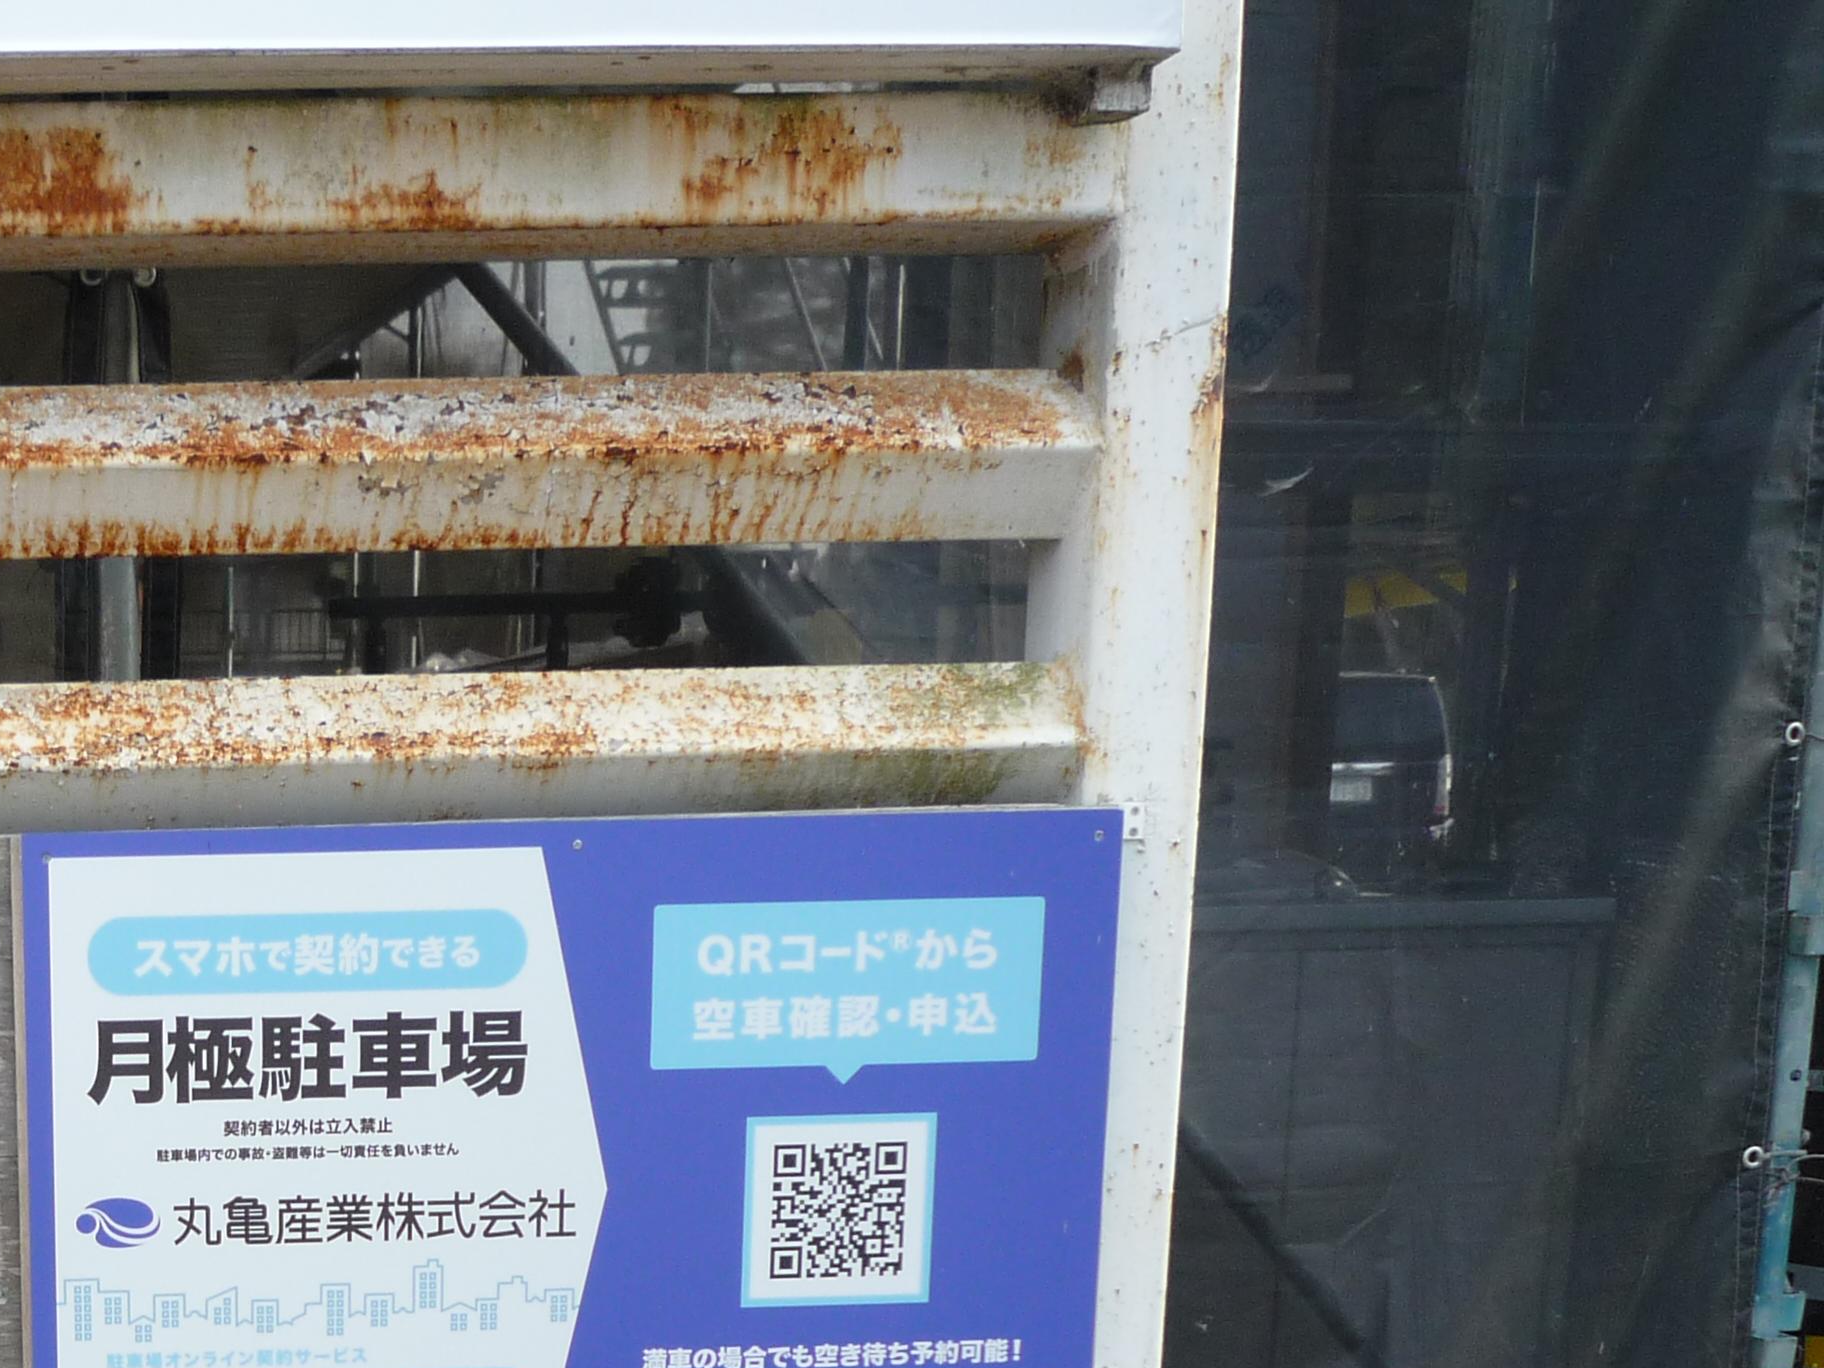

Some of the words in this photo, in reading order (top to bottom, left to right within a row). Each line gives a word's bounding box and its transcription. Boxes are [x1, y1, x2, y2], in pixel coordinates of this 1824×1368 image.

[134, 935, 481, 977] スマホで契約できる
[692, 992, 998, 1040] 空車確認・申込
[88, 1010, 529, 1105] 月極駐車場
[223, 1117, 393, 1137] 契約者以外は立入禁止
[156, 1143, 459, 1162] 駐車場内での事故・盗難等は一切責任を負いません
[173, 1189, 578, 1247] 丸亀産業株式会社
